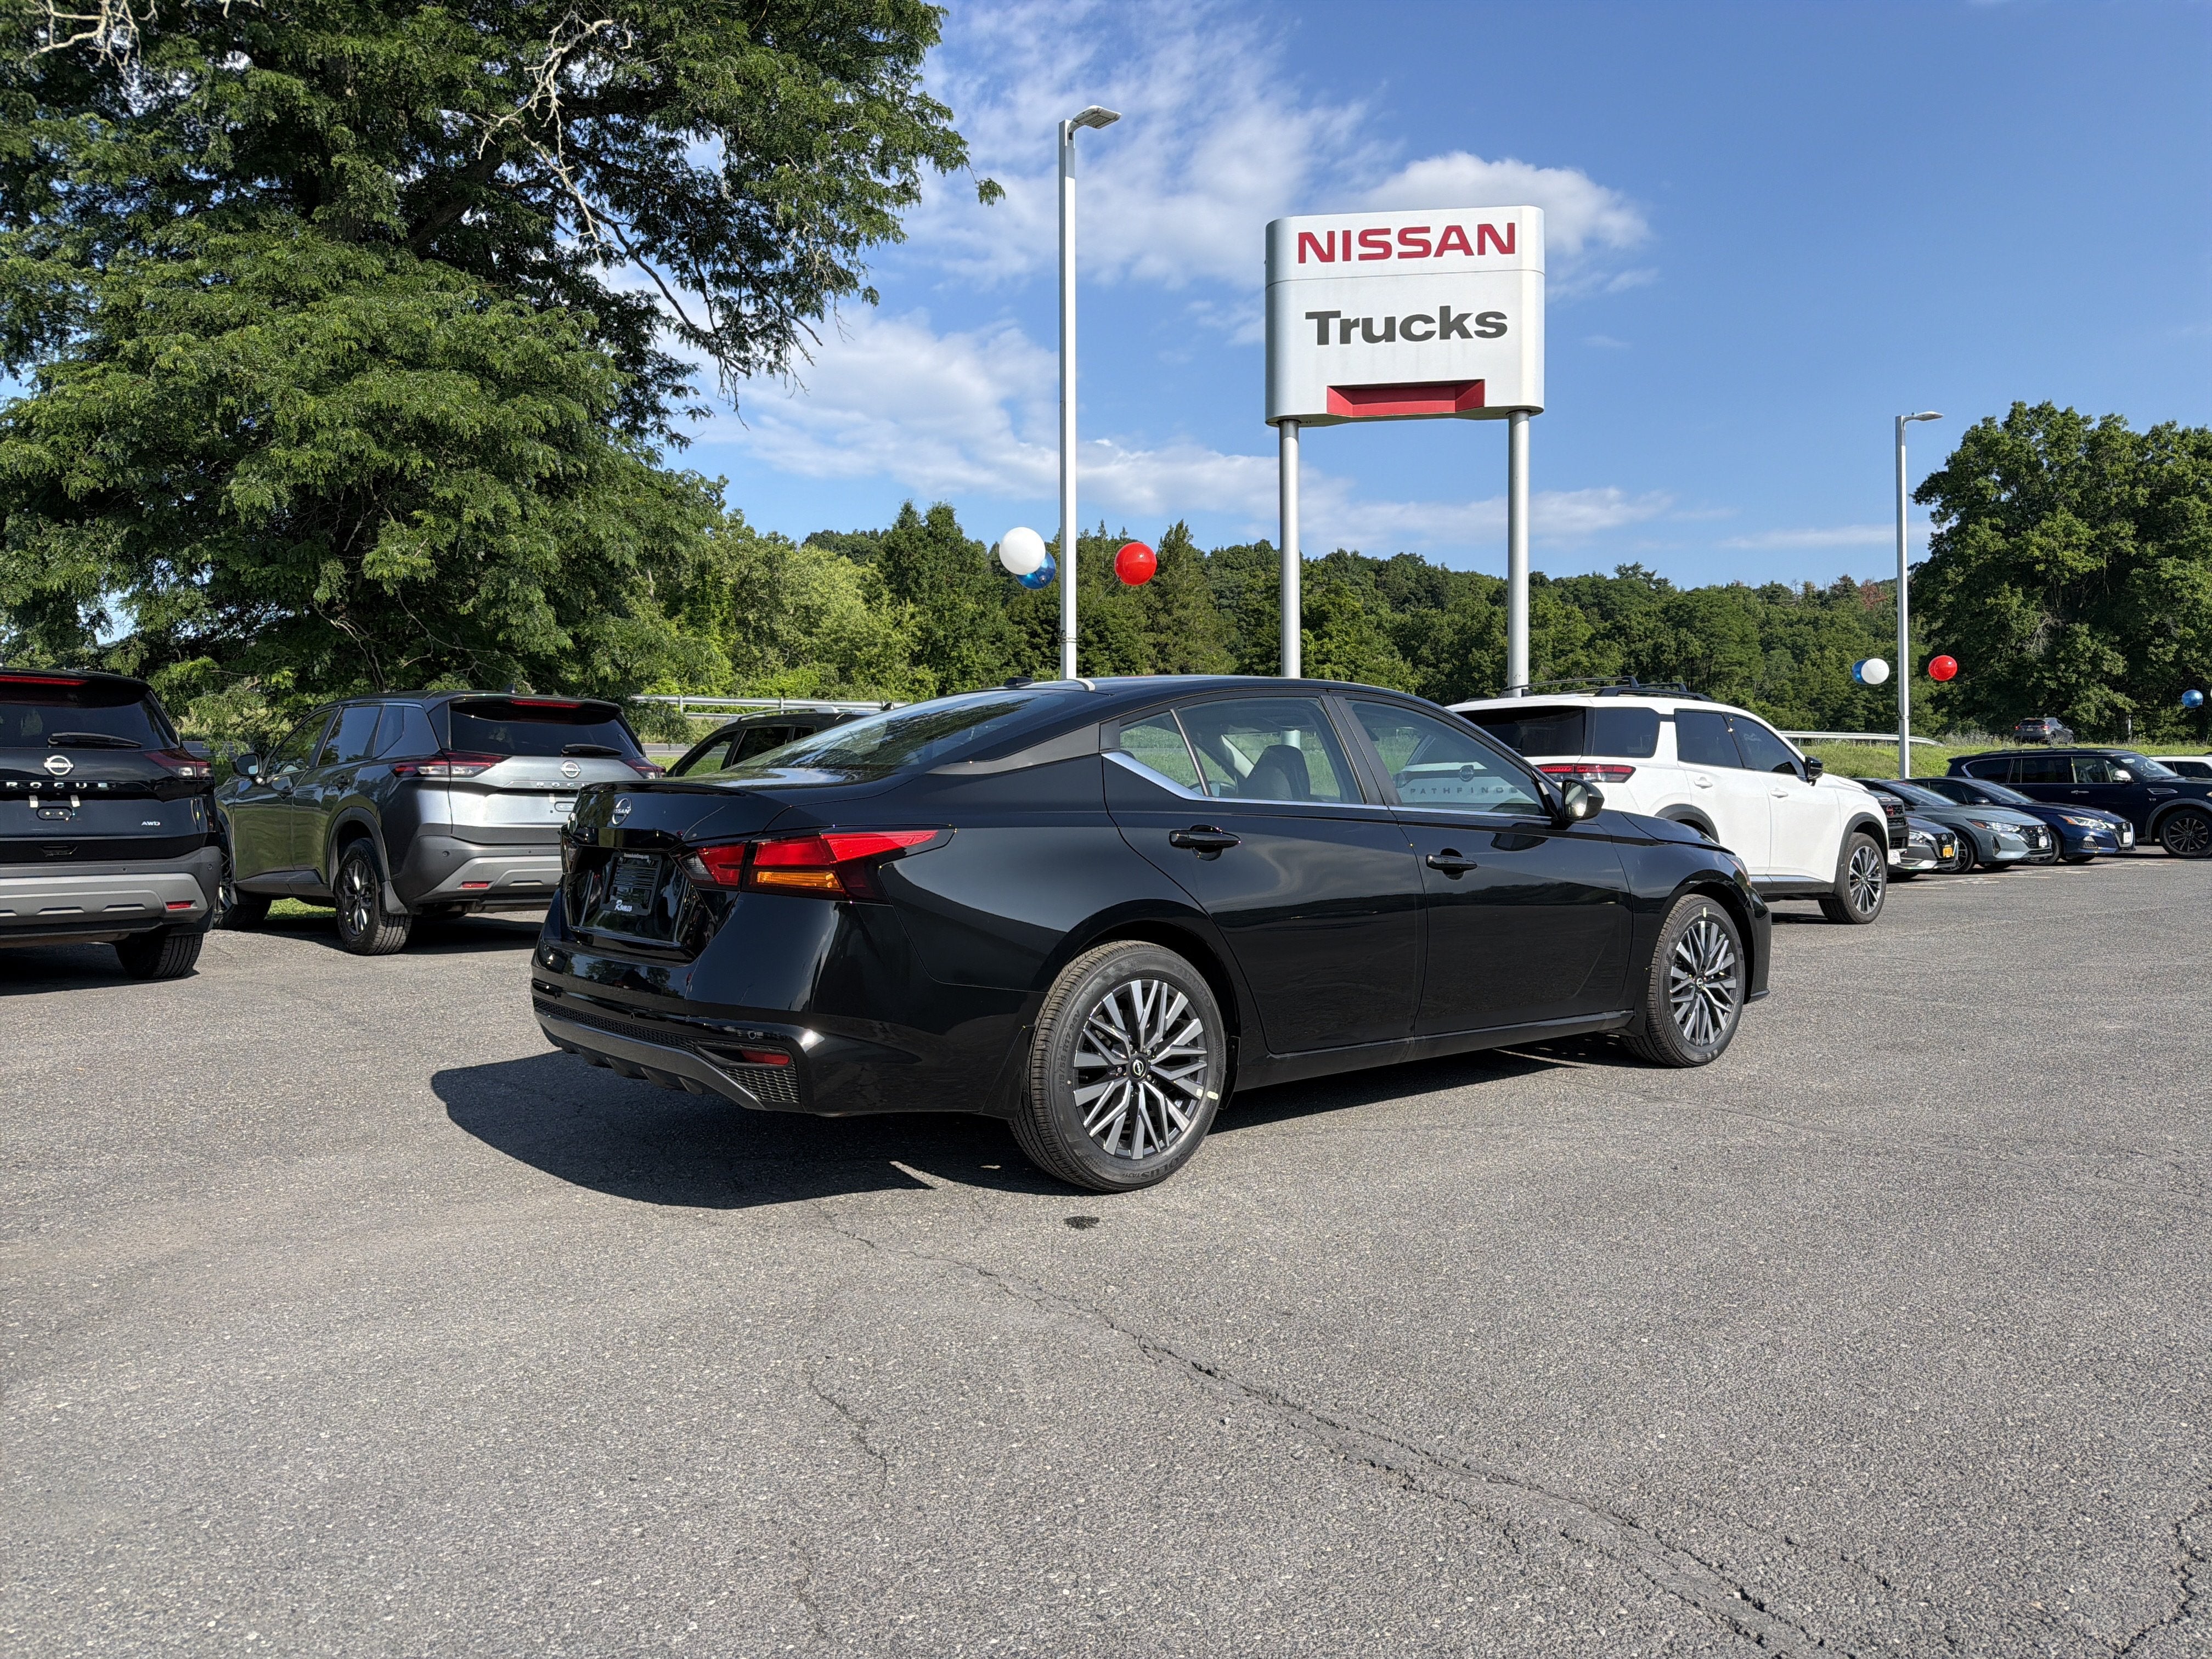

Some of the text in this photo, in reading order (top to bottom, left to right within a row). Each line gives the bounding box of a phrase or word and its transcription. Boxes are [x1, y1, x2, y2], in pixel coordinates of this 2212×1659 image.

[1298, 222, 1515, 263] NISSAN
[1305, 306, 1508, 345] Trucks
[6, 781, 110, 790] ROGUE
